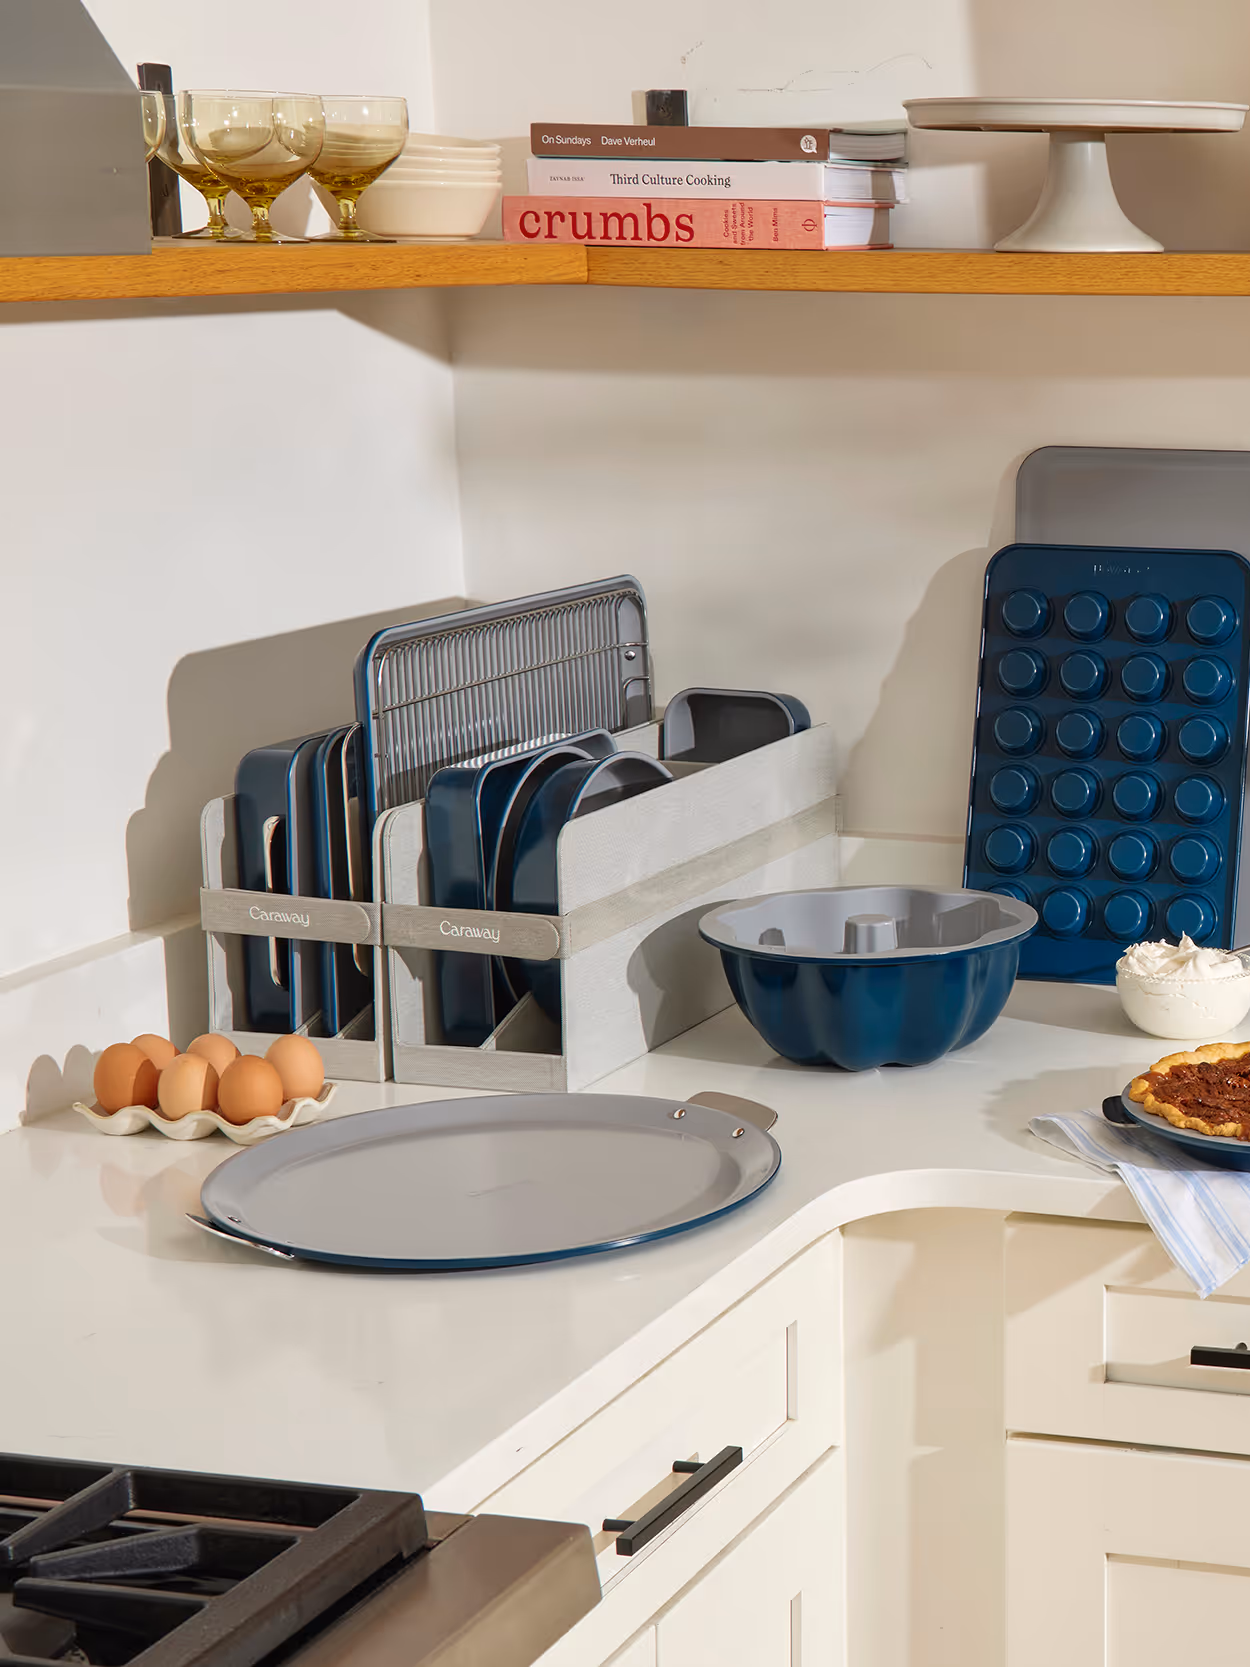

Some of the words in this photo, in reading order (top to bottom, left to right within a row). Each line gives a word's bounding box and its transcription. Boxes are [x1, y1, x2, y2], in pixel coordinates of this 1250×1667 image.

[541, 134, 555, 144] On
[555, 134, 592, 147] Sundays
[601, 135, 622, 146] Dave
[623, 136, 656, 147] Verheul
[609, 173, 639, 185] Third
[641, 173, 683, 186] Culture
[685, 174, 732, 189] Cooking
[518, 202, 695, 243] crumbs
[249, 905, 310, 928] Caraway
[439, 920, 500, 944] Caraway
